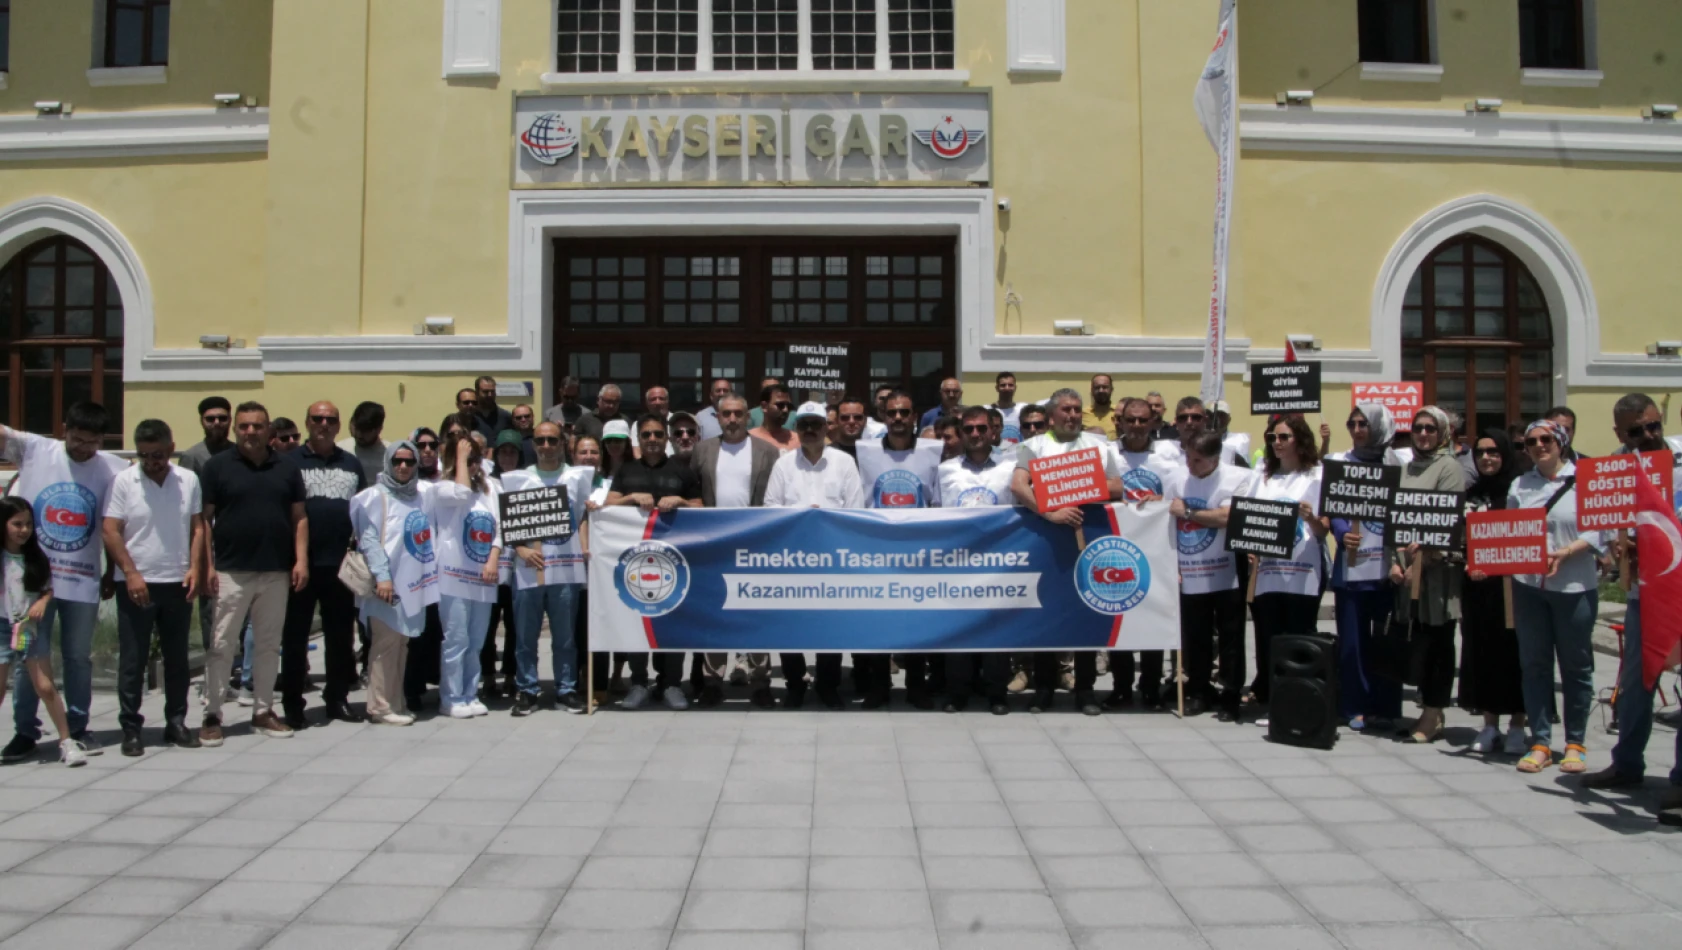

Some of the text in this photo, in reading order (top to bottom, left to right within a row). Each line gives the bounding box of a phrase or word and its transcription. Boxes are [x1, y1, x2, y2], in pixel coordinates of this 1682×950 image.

[581, 108, 908, 158] KAYSERİ GAR
[789, 344, 848, 356] EMEKLİLERİN
[806, 355, 829, 366] MALİ
[794, 367, 840, 378] KAYIPLARI
[1262, 365, 1309, 376] KORUYUCU
[788, 378, 845, 390] GİDERİLSİN
[1273, 376, 1298, 387] GİYİM
[1354, 385, 1418, 394] FAZLA
[1268, 389, 1303, 398] YARDIMI
[1355, 395, 1417, 406] MESAİ
[1252, 400, 1319, 411] ENGELLENEMEZ
[1032, 450, 1097, 472] LOJMANLAR
[1594, 456, 1653, 474] 3600-K
[1040, 463, 1095, 483] MEMURUN
[1343, 465, 1383, 480] TOPLU
[1047, 476, 1094, 494] ELİNDEN
[508, 487, 558, 503] SERVİS
[1046, 487, 1101, 508] ALINAMAZ
[1394, 492, 1458, 508] EMEKTEN
[506, 498, 562, 516] HİZMETİ
[1236, 501, 1293, 516] MÜHENDİSLİK
[502, 511, 570, 529] HAKKIMIZ
[1245, 515, 1279, 527] MESLEK
[1390, 511, 1459, 527] TASARRUF
[504, 523, 570, 542] ENGELLENEMEZ
[1242, 528, 1278, 540] KANUNU
[1394, 528, 1451, 546] EDİLMEZ
[1470, 520, 1544, 540] KAZANIMLARIMIZ
[1230, 539, 1287, 555] ÇIKARTILMALI
[1474, 545, 1541, 565] ENGELLENEMEZ
[735, 548, 1030, 567] Emekten Tasarruf Edilemez
[737, 582, 1028, 603] Kazanımlarımız Engellenemez
